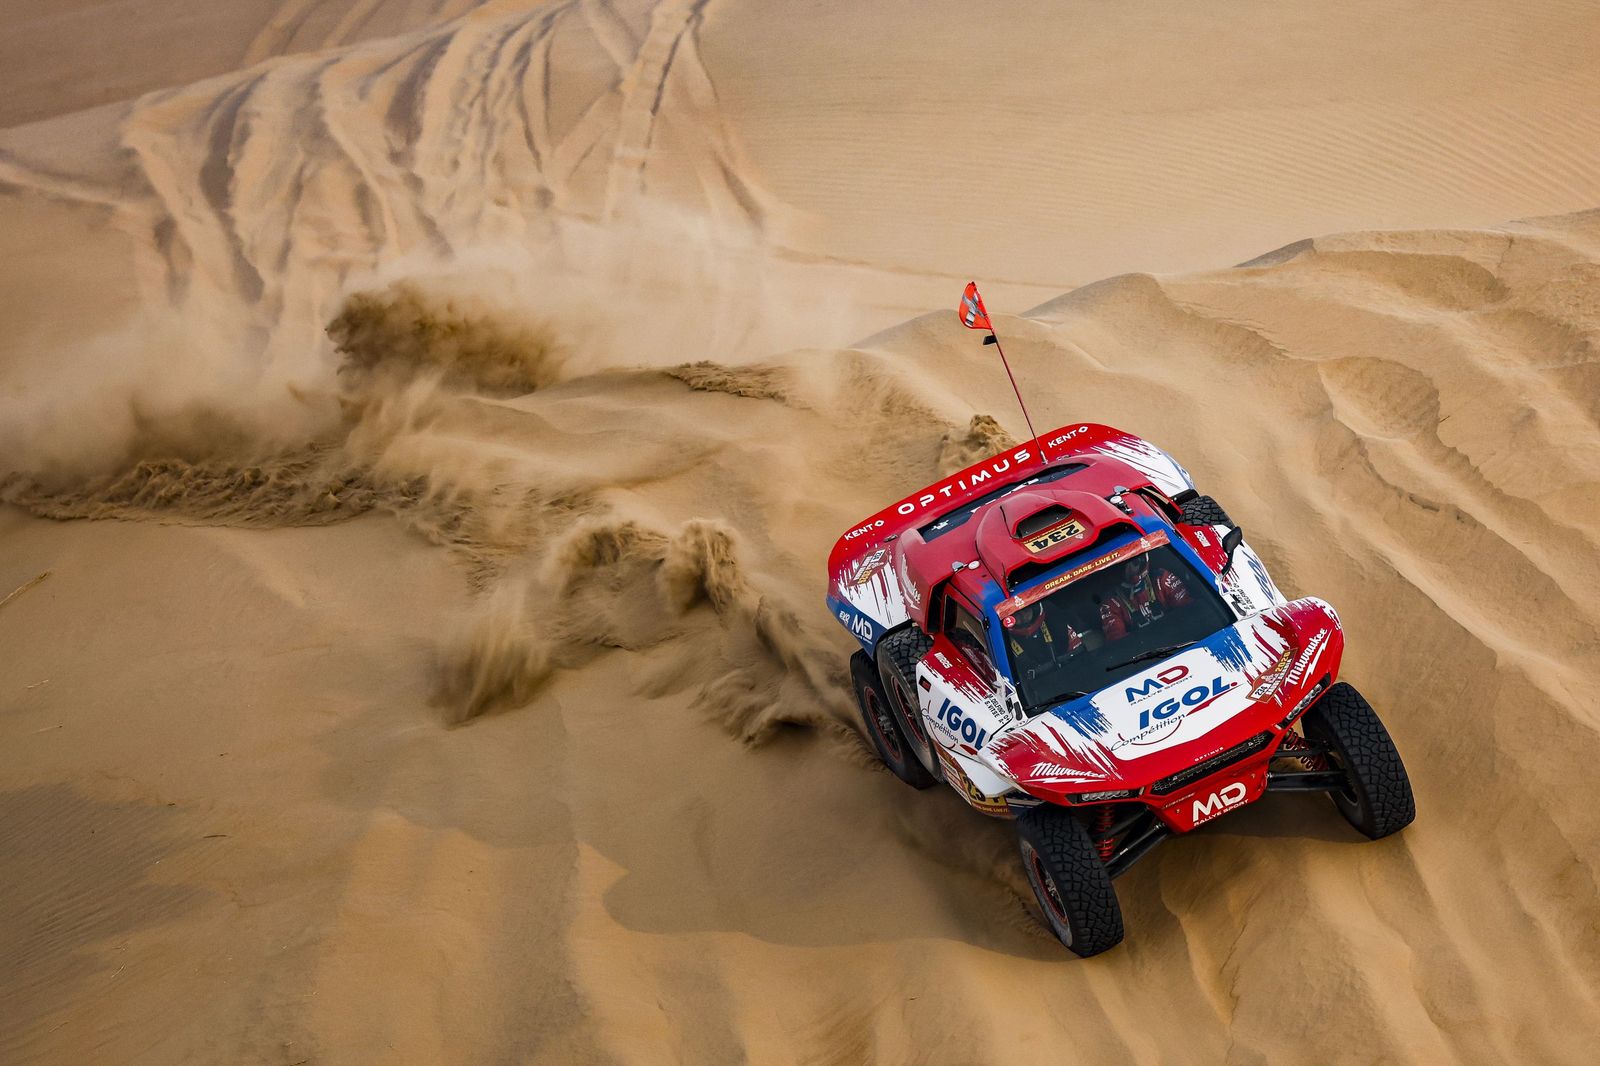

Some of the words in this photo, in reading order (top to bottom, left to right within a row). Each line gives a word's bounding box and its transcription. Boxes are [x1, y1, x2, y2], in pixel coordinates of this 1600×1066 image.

[897, 448, 1032, 515] OPTIMUS
[1031, 524, 1080, 550] 234
[1045, 574, 1073, 590] DREAM.
[1073, 565, 1095, 576] DARE.
[1095, 557, 1111, 567] LIVE
[851, 614, 873, 640] MD
[1274, 651, 1291, 673] 2020
[1283, 627, 1328, 687] Milwaukee
[1125, 665, 1189, 703] MD
[1130, 689, 1162, 706] RALLYE
[1254, 685, 1268, 697] 234
[921, 707, 959, 743] Compétition
[1111, 713, 1185, 751] Compétition
[1030, 761, 1107, 779] Milwaukee
[1192, 782, 1247, 823] MD
[1193, 811, 1222, 827] RALLYE
[1223, 798, 1249, 813] SPORT
